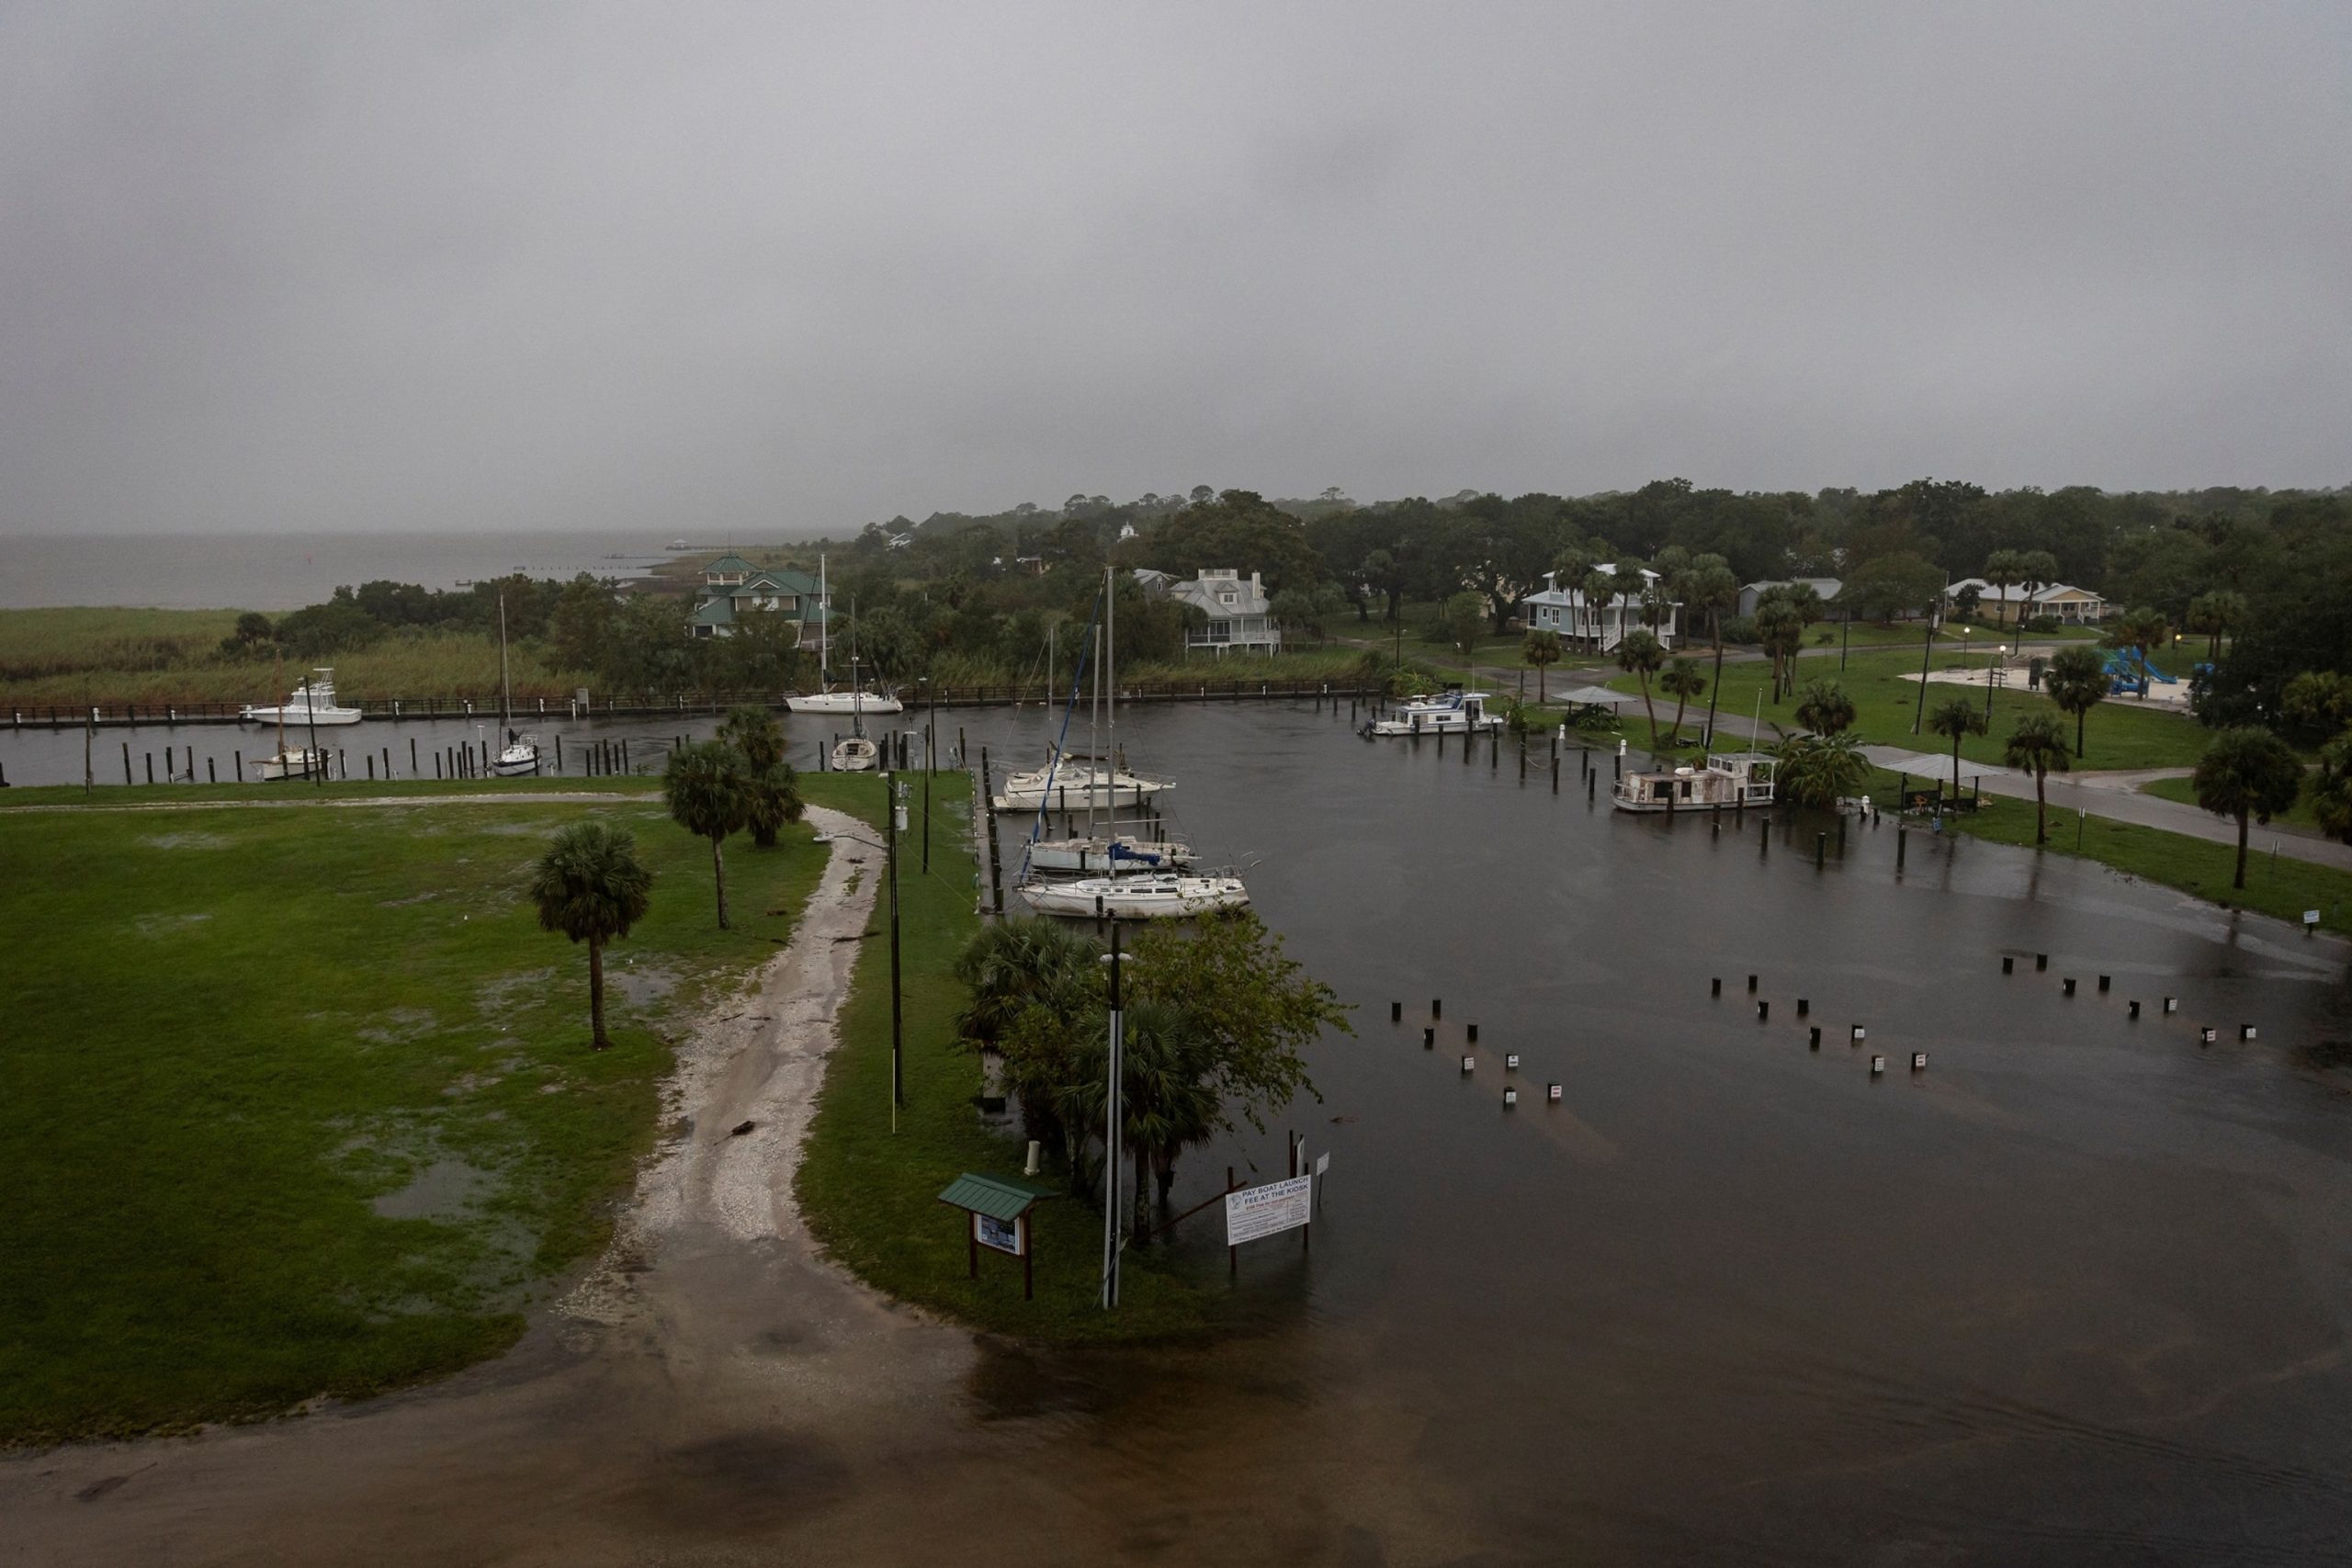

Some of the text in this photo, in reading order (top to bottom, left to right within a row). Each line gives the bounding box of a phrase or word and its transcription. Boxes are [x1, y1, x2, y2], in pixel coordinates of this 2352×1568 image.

[1242, 1178, 1308, 1198] PAY BOAT LAUNCH
[1244, 1195, 1259, 1204] FEE
[1261, 1193, 1271, 1201] AT
[1272, 1190, 1285, 1198] THE
[1286, 1184, 1308, 1193] KIOSK
